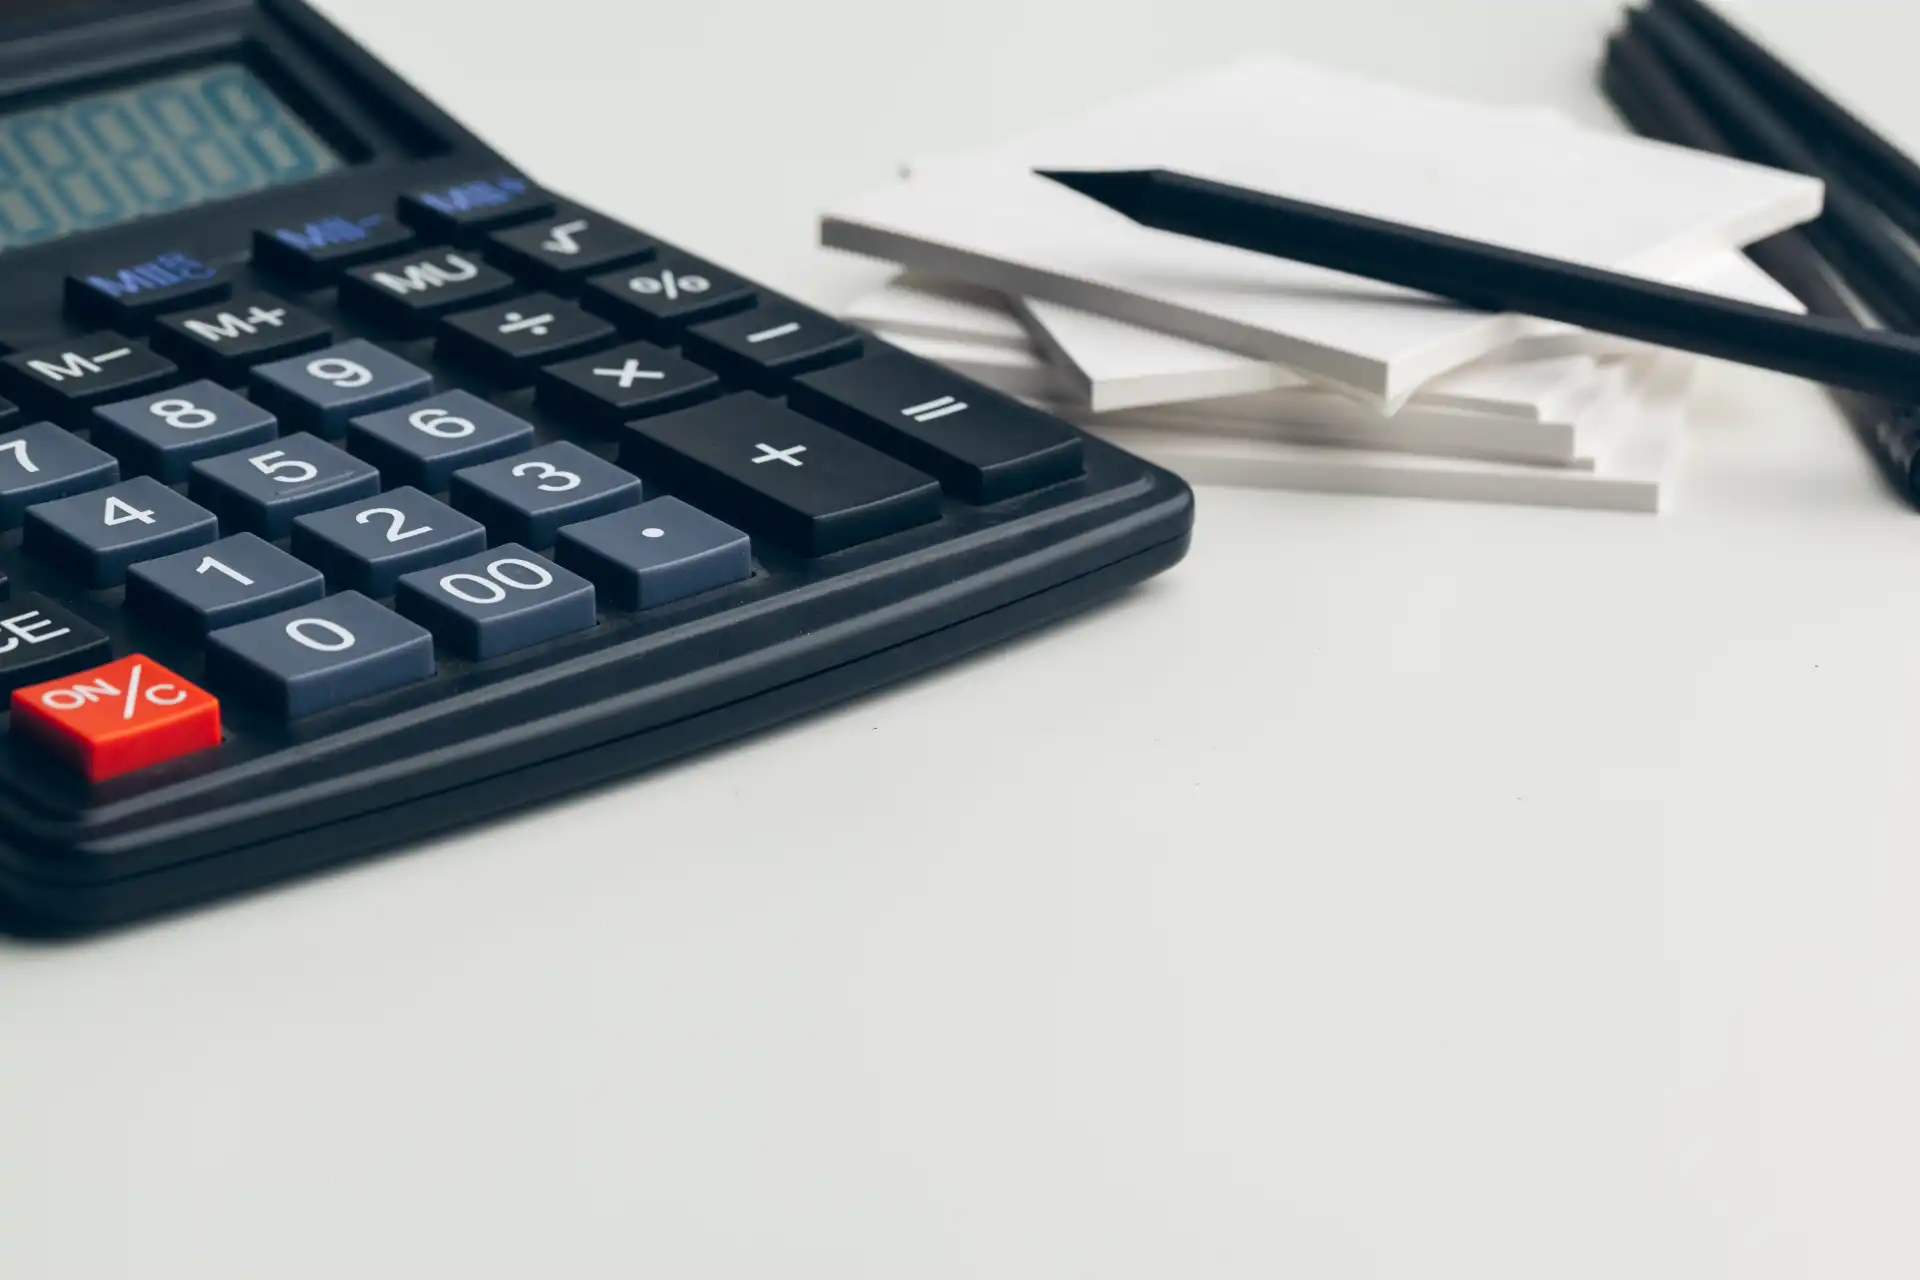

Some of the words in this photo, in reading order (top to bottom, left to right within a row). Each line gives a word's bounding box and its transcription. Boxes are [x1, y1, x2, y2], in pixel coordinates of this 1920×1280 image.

[373, 254, 478, 294] MU
[184, 305, 286, 342] M+
[27, 348, 131, 381] M-
[305, 357, 375, 388] 9
[149, 398, 218, 430] 8
[408, 408, 477, 439] 6
[0, 439, 40, 473] 7
[247, 450, 319, 483] 5
[511, 461, 583, 492] 3
[103, 496, 157, 527] 4
[355, 507, 434, 543] 2
[195, 555, 255, 587] 1
[439, 557, 555, 605] 00
[285, 617, 356, 652] 0
[41, 664, 188, 720] ON/C
